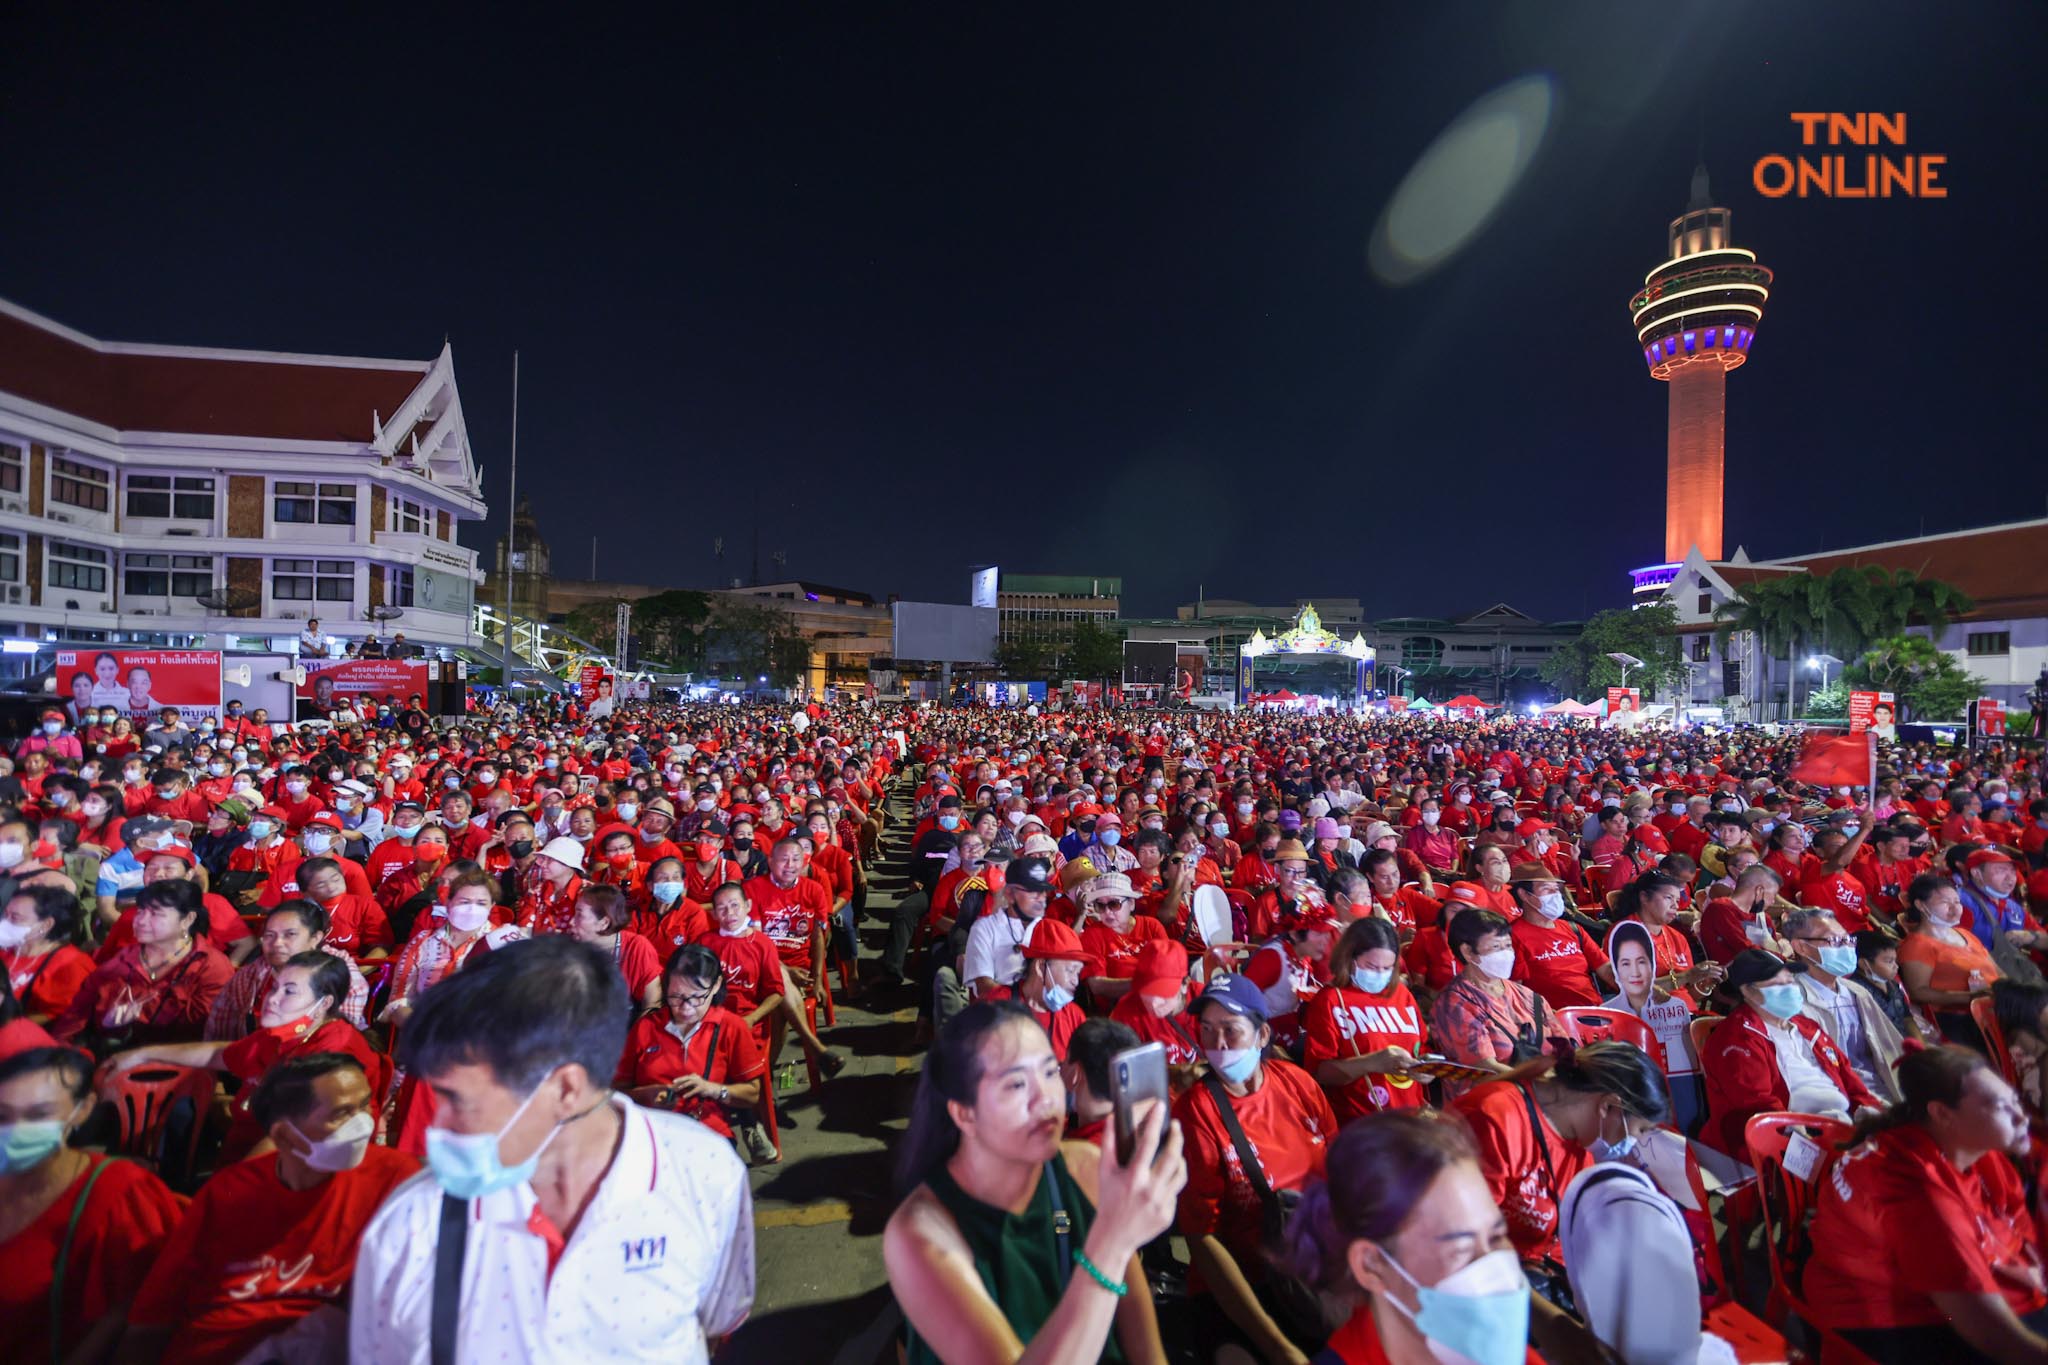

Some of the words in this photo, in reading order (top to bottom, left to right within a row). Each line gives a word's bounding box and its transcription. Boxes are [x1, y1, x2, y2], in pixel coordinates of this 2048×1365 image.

[123, 654, 157, 665] สงคราม
[351, 664, 397, 673] พรรคเพื่อไทย
[1646, 1004, 1686, 1022] นฤมล
